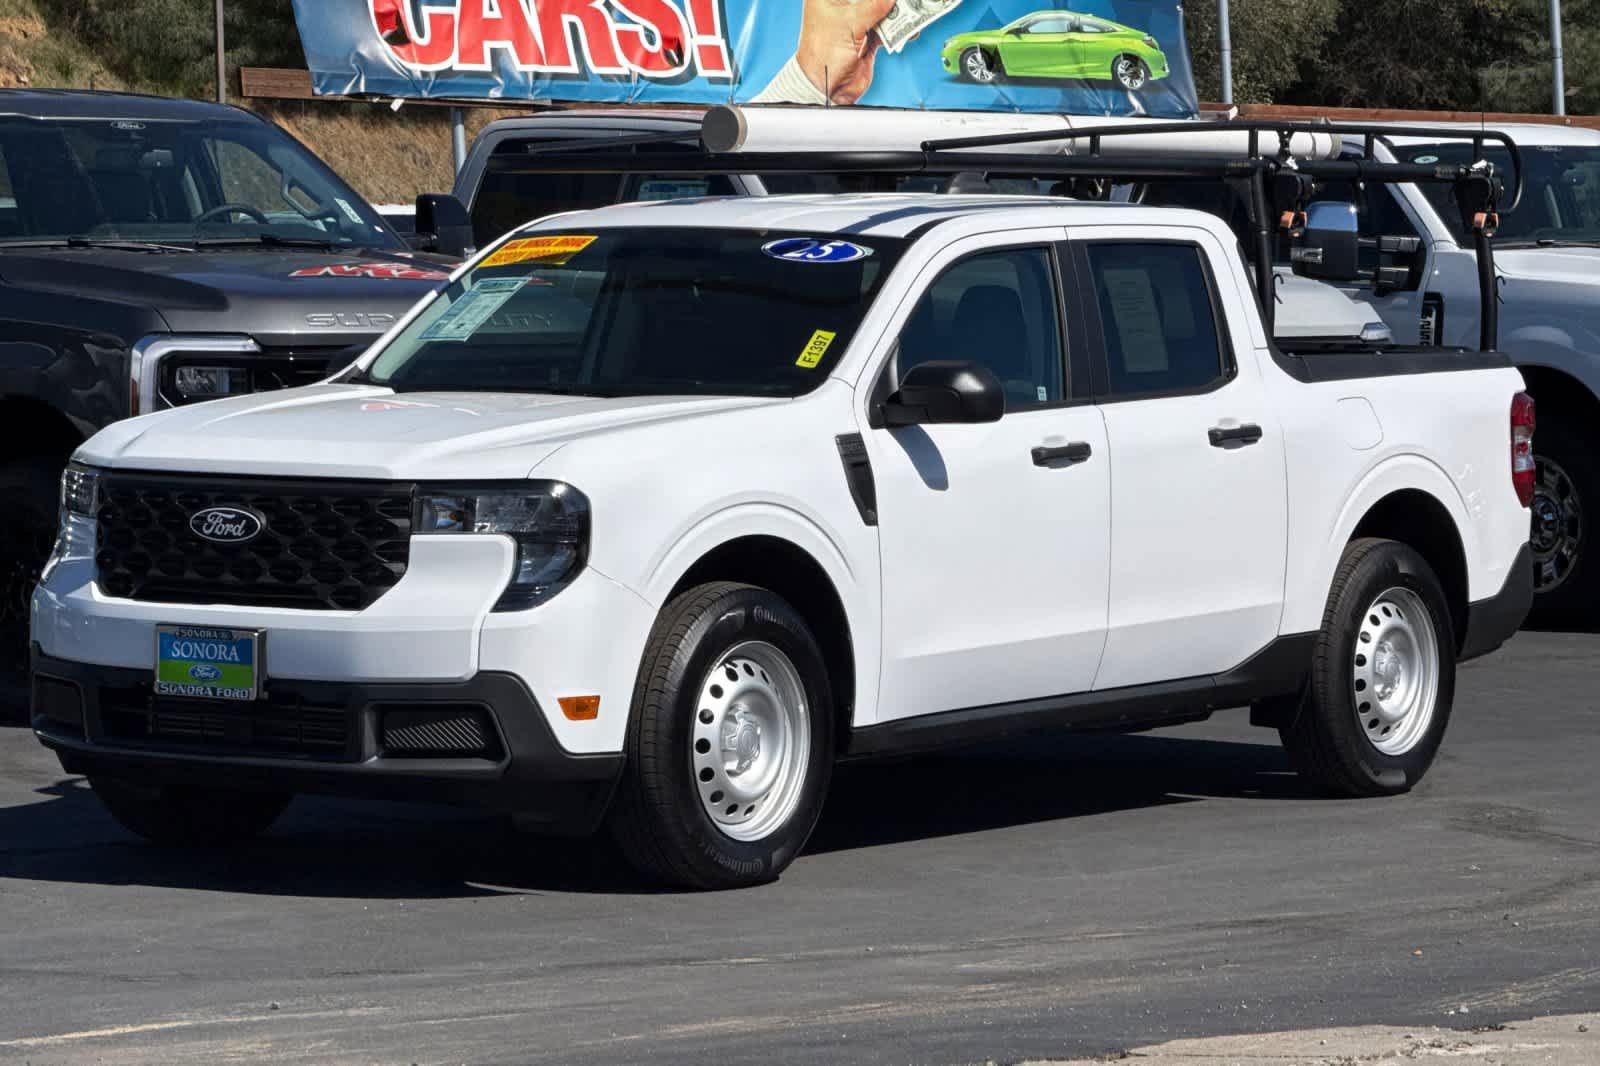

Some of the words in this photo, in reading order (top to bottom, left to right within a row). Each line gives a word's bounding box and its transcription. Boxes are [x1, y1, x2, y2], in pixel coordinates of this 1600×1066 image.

[781, 240, 845, 258] 25
[305, 312, 401, 328] SUP
[488, 312, 553, 328] UTY
[802, 334, 830, 363] F1397
[202, 511, 246, 537] Ford
[171, 641, 241, 662] SONORA
[193, 664, 218, 679] Ford
[160, 683, 212, 696] SONORA
[216, 687, 249, 699] FORD
